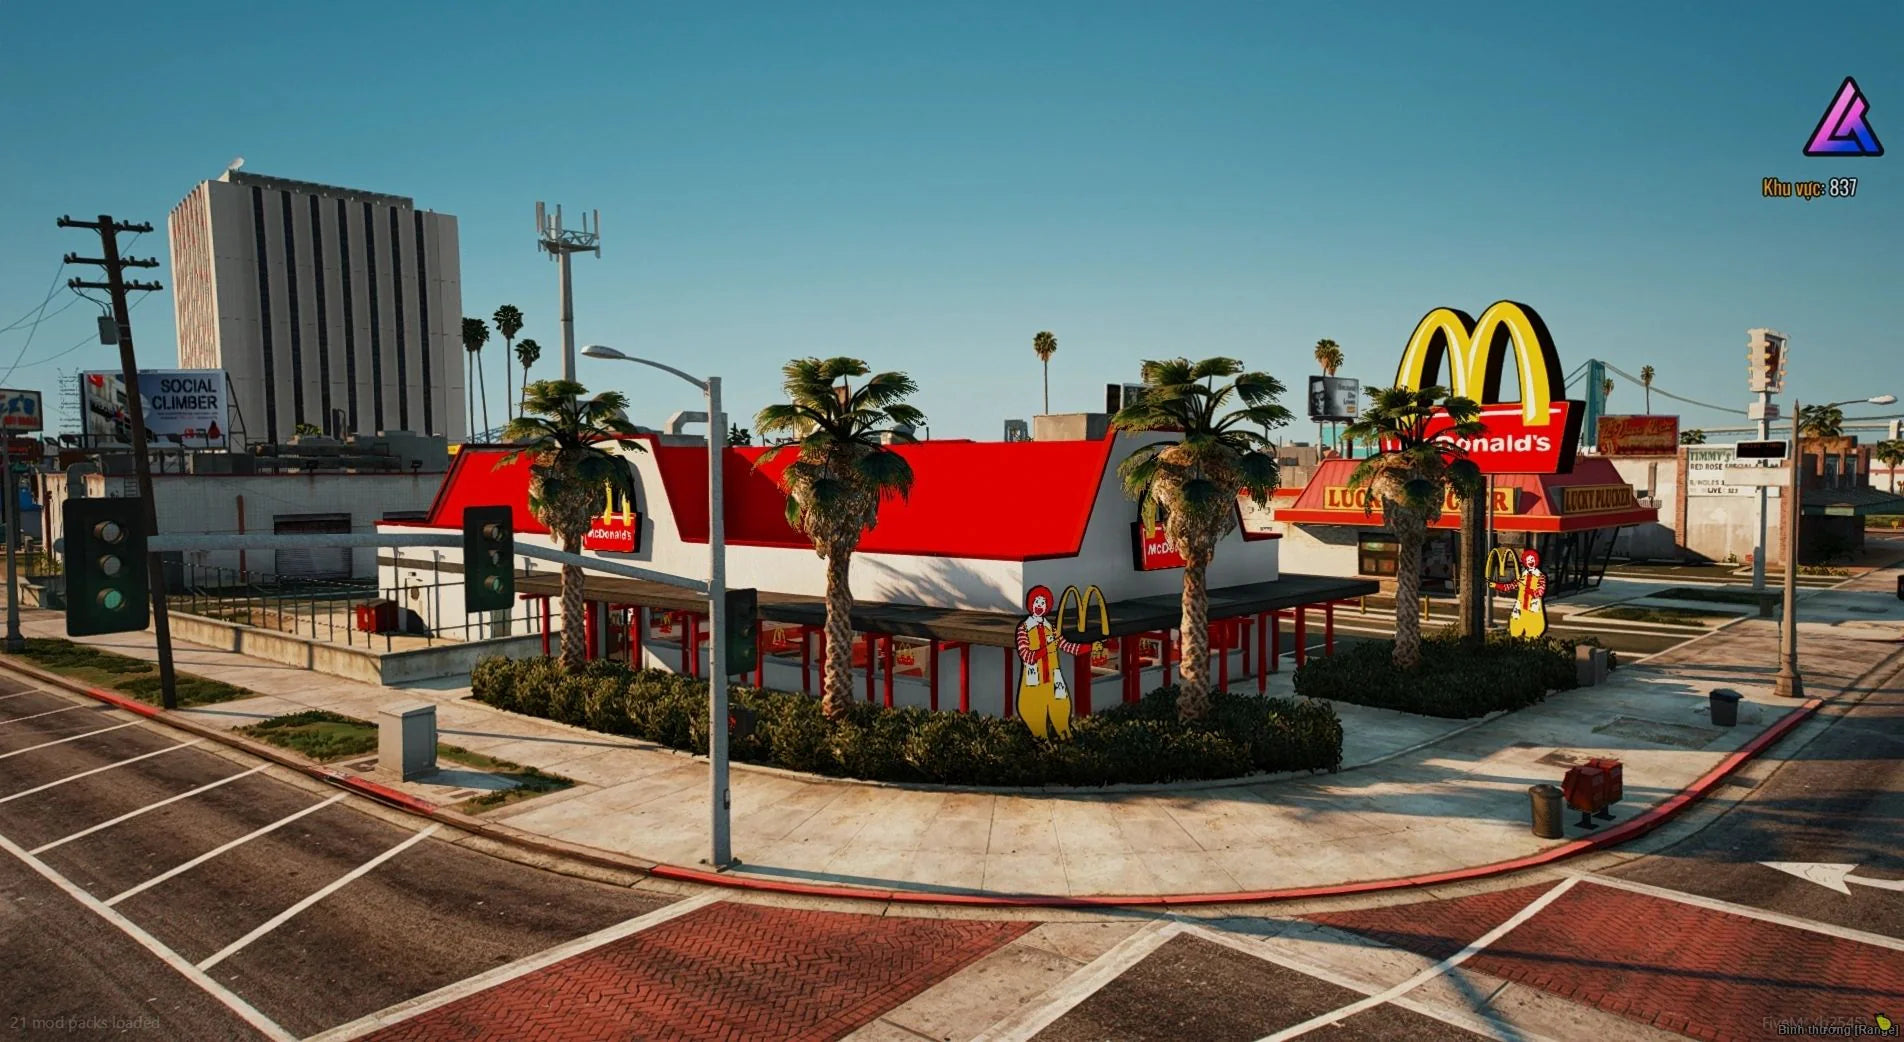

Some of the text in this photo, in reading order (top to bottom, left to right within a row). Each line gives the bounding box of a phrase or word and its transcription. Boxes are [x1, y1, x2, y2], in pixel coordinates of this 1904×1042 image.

[161, 378, 217, 393] SOCIAL
[152, 395, 219, 411] CLIMBER
[1705, 463, 1722, 471] ROSE
[1565, 490, 1594, 511] LUCKY
